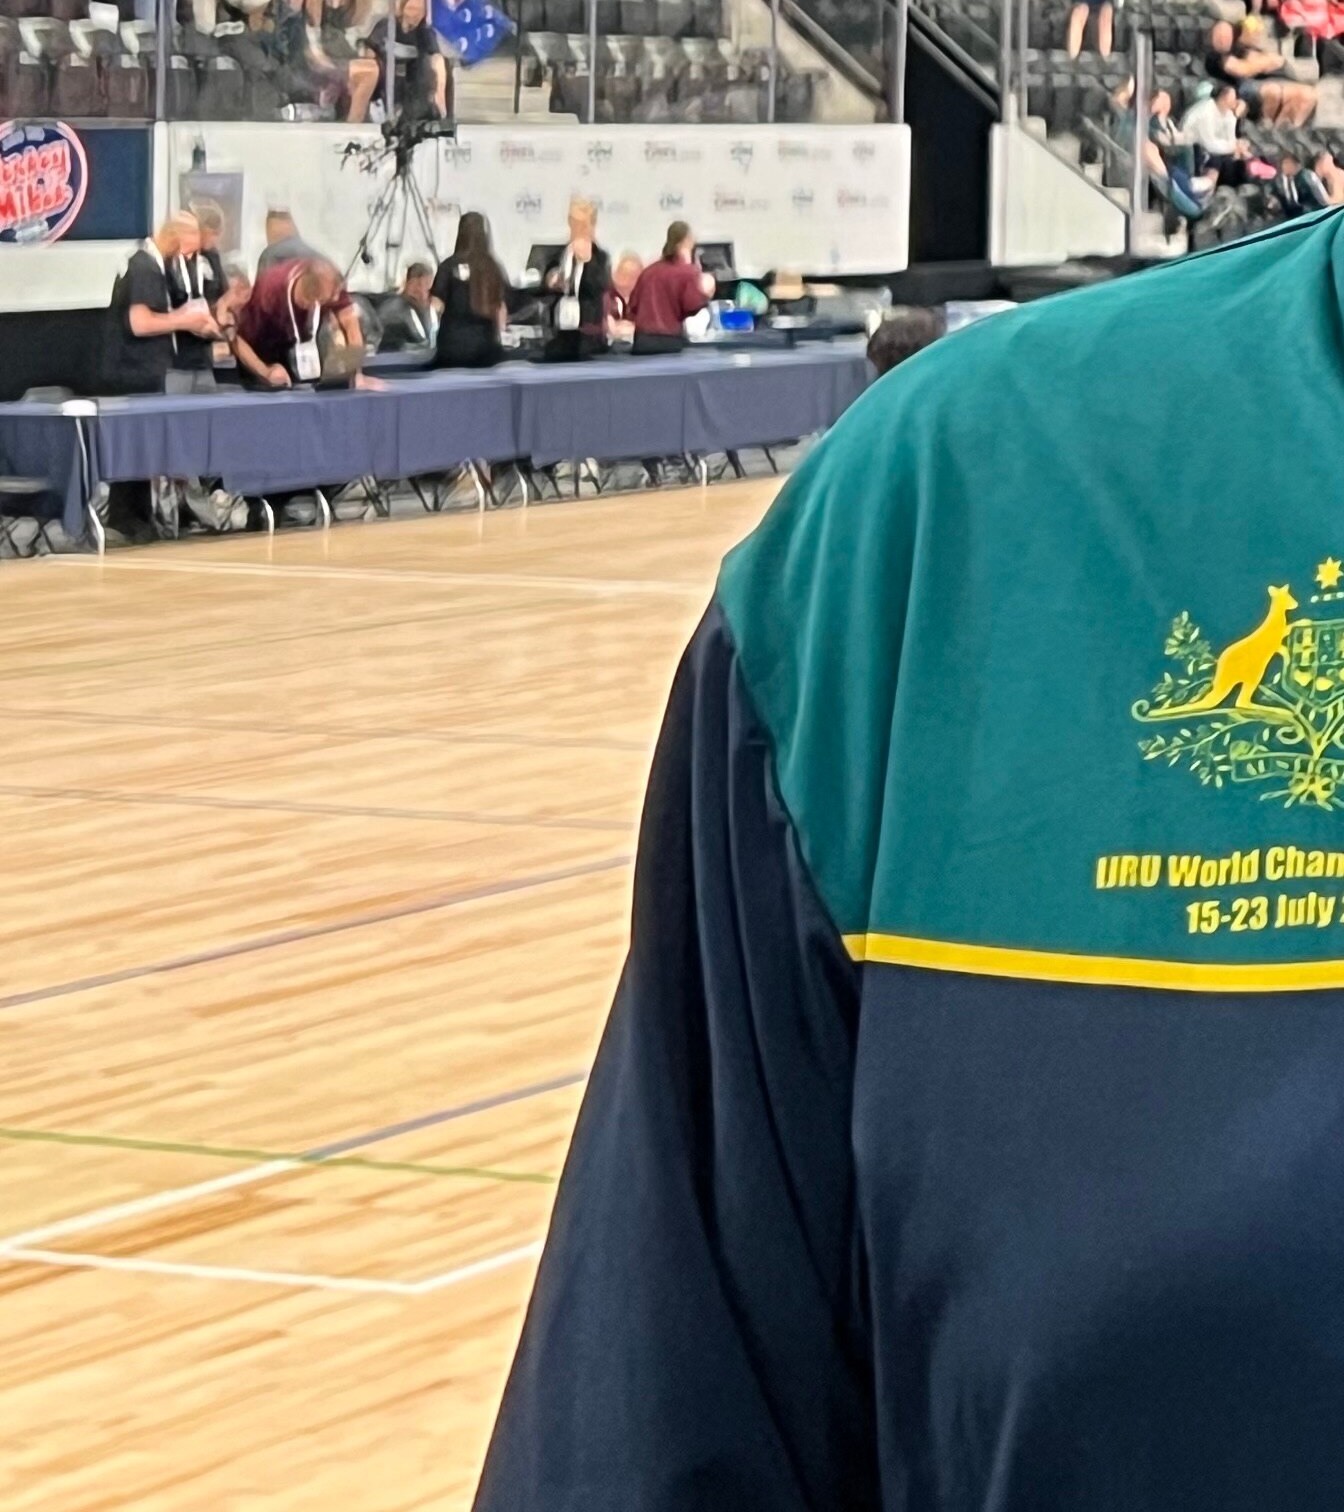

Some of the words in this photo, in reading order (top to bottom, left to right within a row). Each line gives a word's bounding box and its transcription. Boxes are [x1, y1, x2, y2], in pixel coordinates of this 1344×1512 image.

[1168, 849, 1260, 887] World
[1187, 896, 1268, 934] 15-23
[1274, 892, 1336, 929] July
